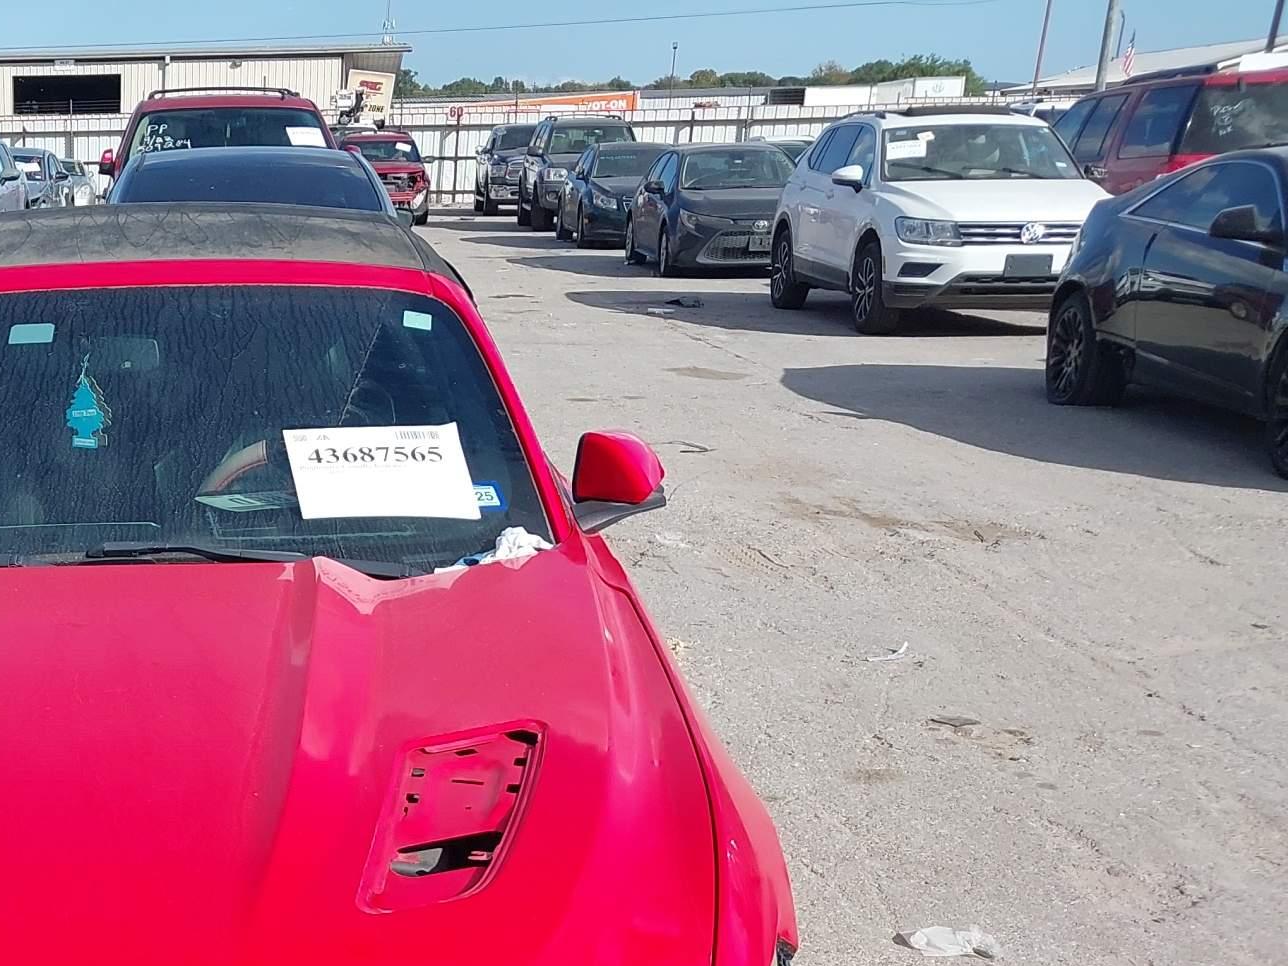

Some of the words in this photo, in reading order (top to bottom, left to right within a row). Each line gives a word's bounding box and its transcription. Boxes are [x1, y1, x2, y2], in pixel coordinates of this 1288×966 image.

[368, 104, 385, 113] ZONE
[307, 446, 443, 464] 43687565
[475, 491, 495, 502] 25
